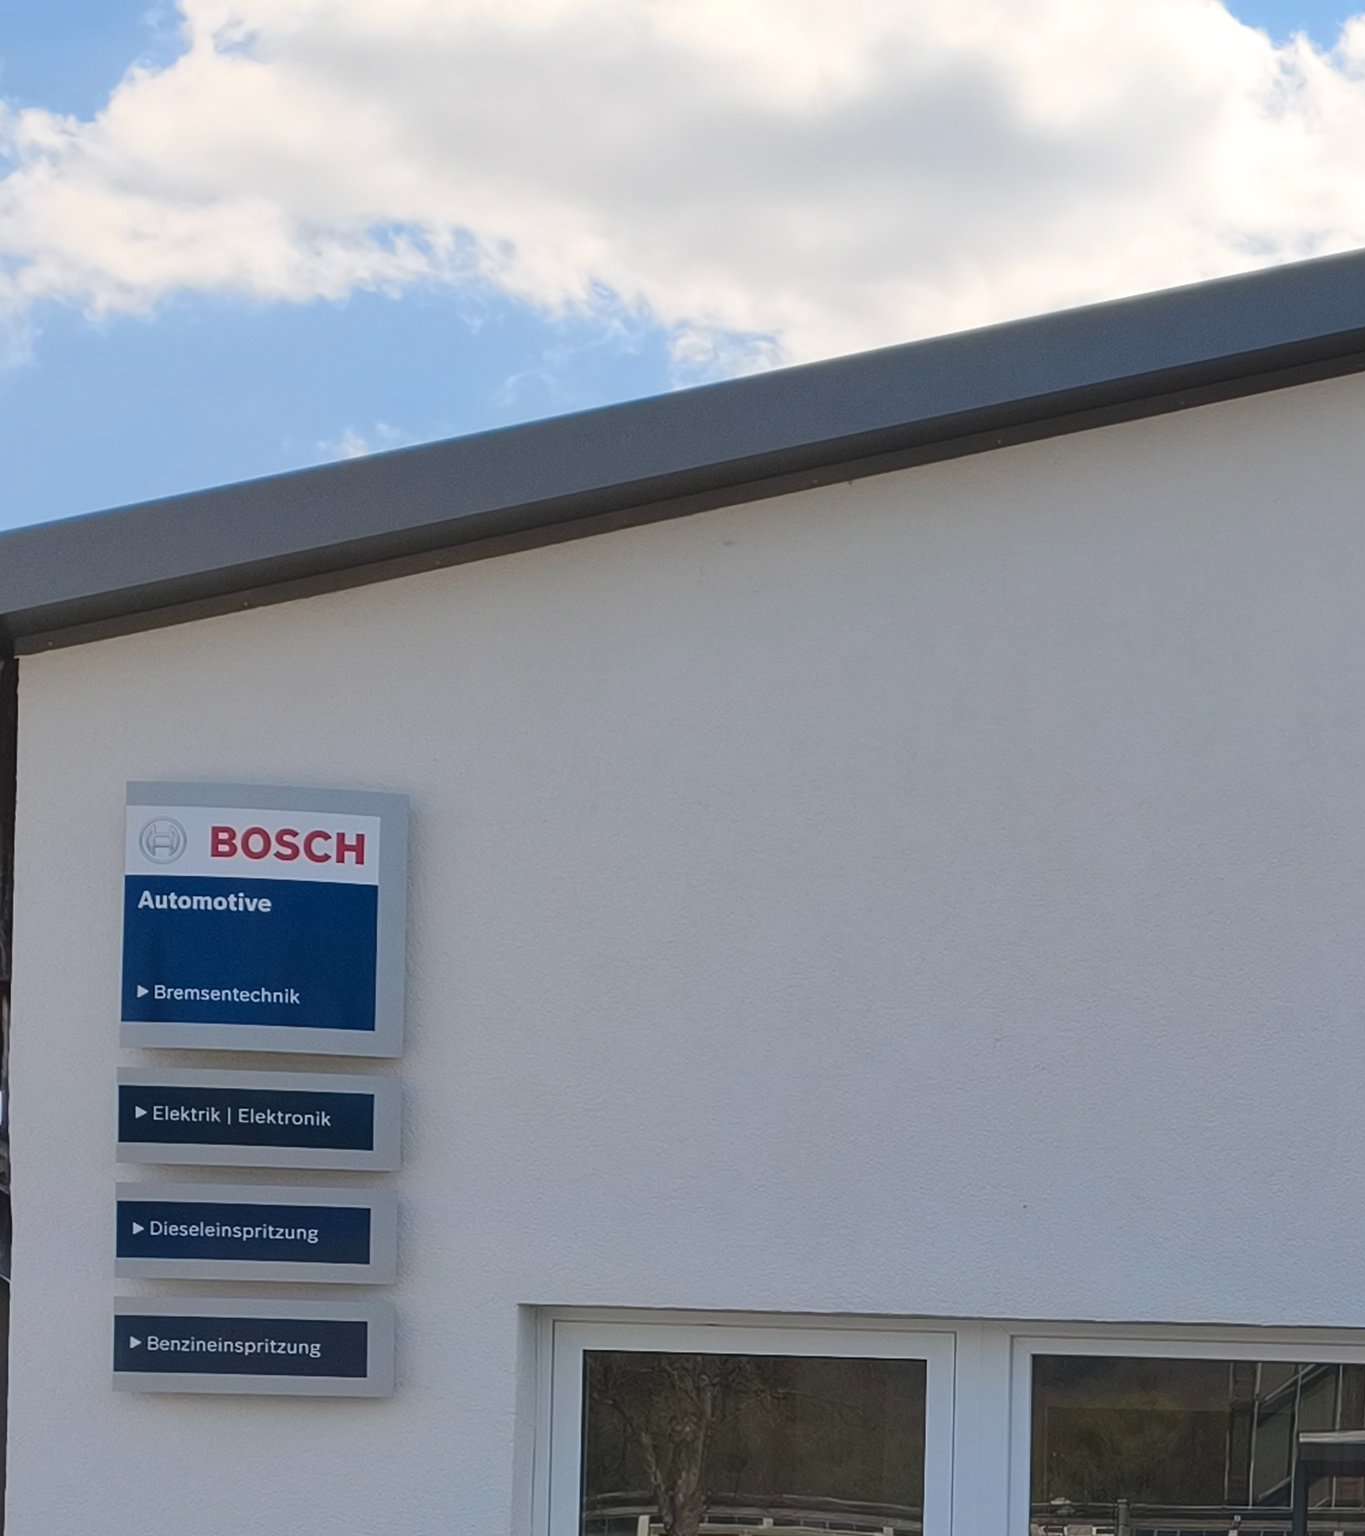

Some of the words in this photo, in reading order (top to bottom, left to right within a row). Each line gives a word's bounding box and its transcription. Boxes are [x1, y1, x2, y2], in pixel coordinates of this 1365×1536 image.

[210, 825, 365, 866] BOSCH
[137, 890, 272, 913] Automotive
[154, 985, 300, 1005] Bremsentechnik
[152, 1105, 221, 1123] Elektrik
[238, 1108, 331, 1127] Elektronik
[150, 1220, 319, 1244] Dieseleinspritzung
[147, 1336, 321, 1359] Benzineinspritzung
